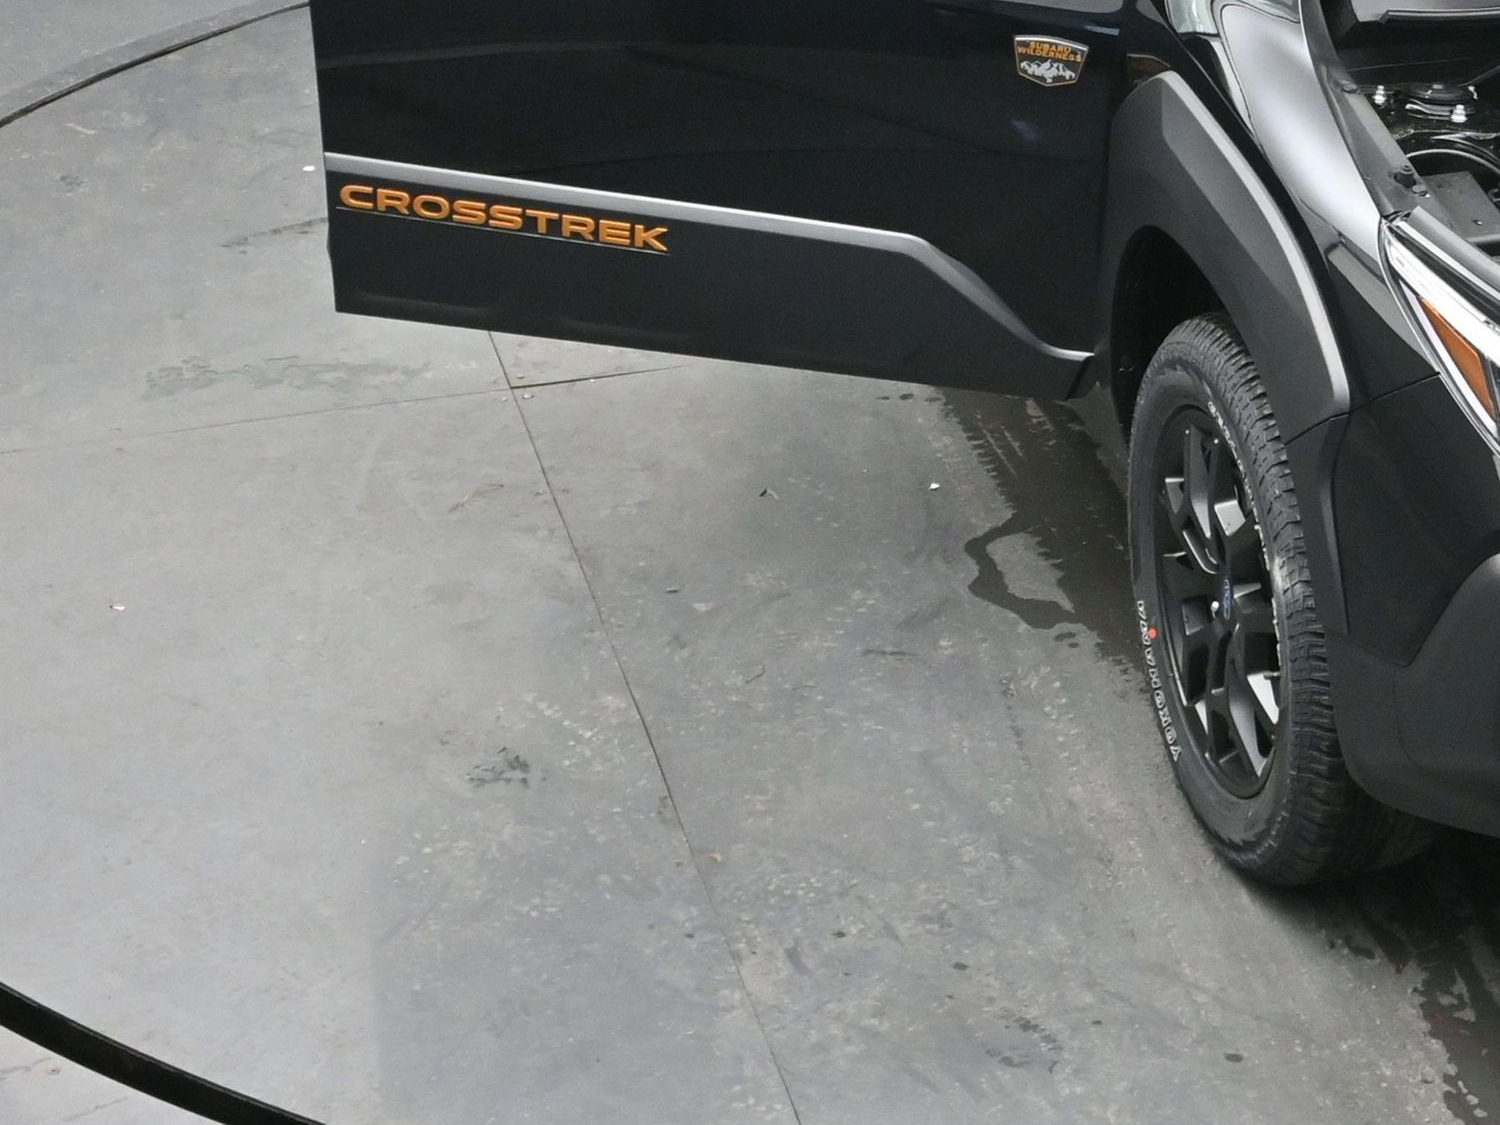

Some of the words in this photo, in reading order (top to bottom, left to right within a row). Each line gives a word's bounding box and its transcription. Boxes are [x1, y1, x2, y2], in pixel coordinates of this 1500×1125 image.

[1017, 46, 1082, 62] WILDERNESS
[1029, 41, 1072, 54] SUBARU
[339, 185, 671, 252] CROSSTREK
